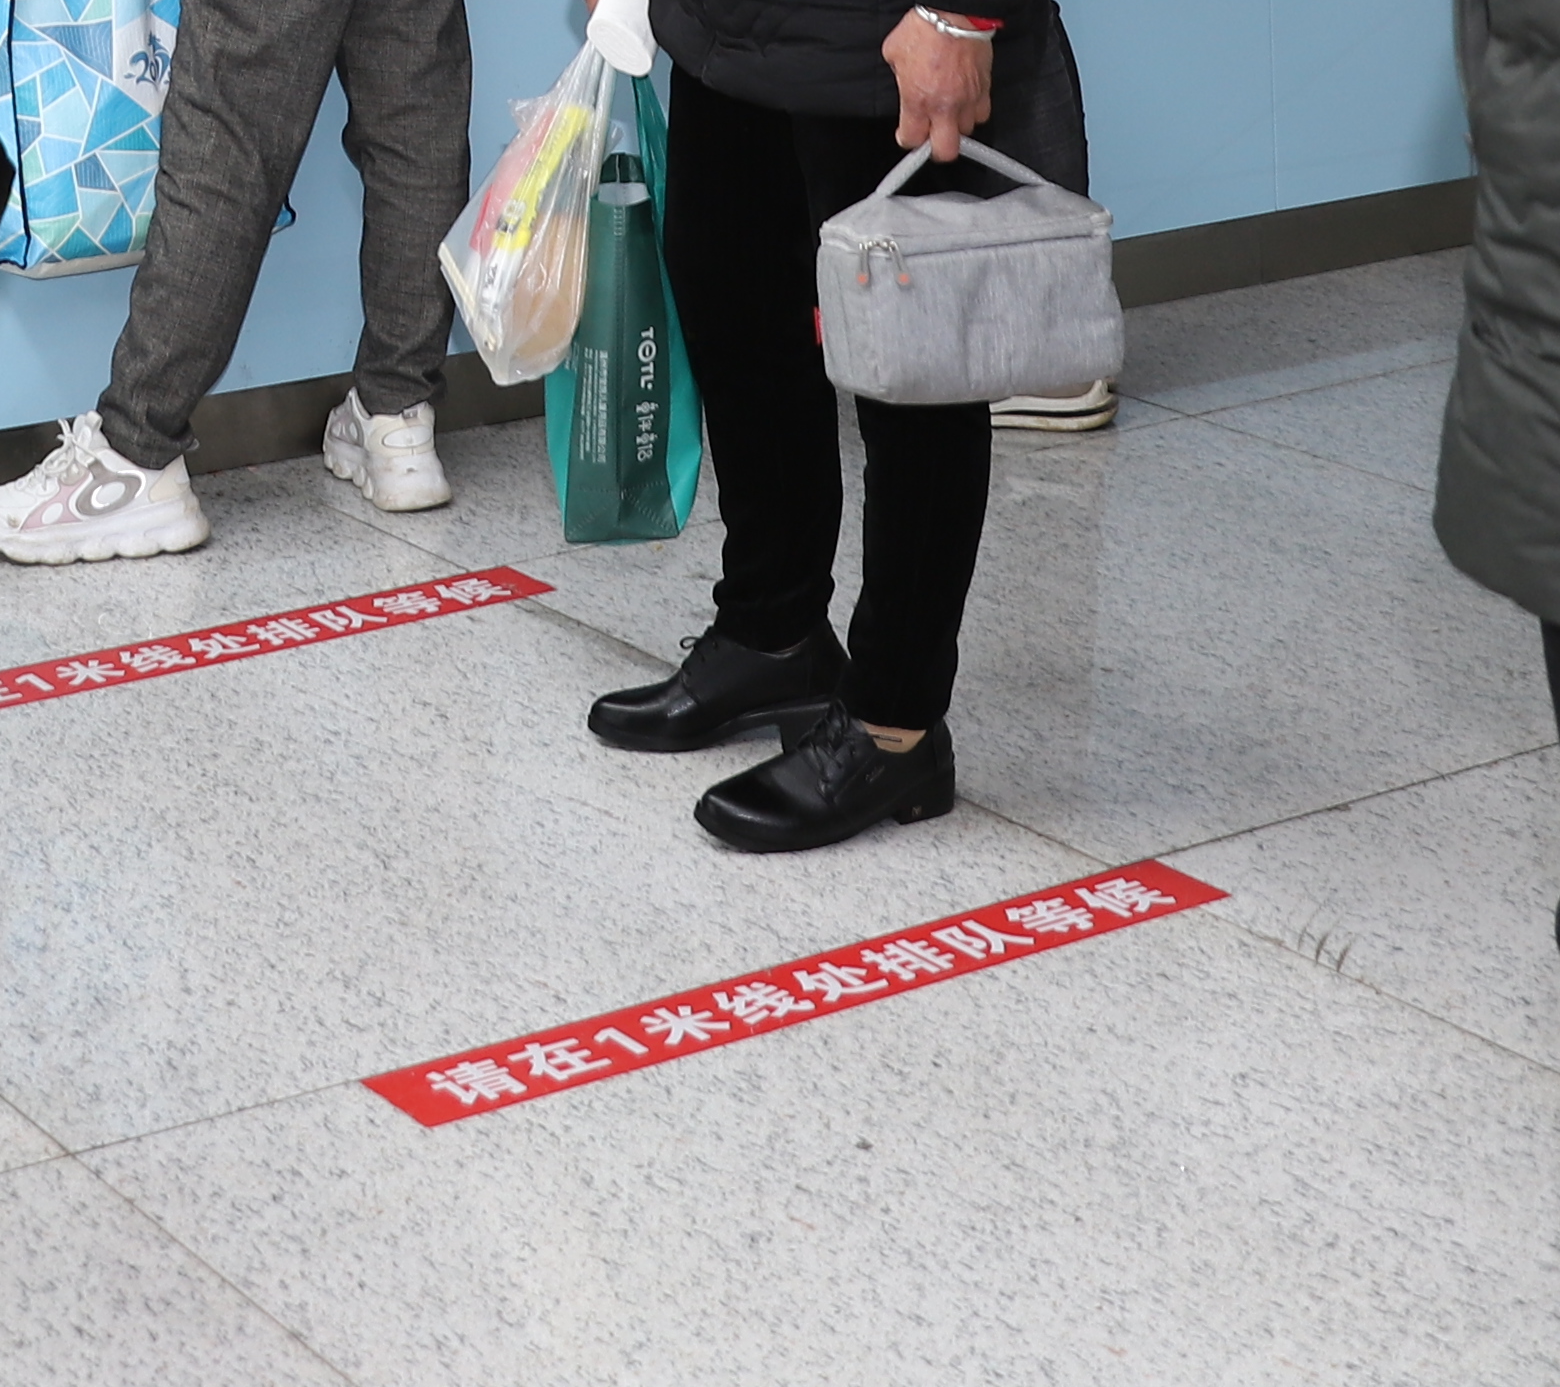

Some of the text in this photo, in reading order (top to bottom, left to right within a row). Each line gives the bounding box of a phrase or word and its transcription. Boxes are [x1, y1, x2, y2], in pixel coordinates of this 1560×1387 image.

[426, 875, 1176, 1108] 请在1米线处排队等候
